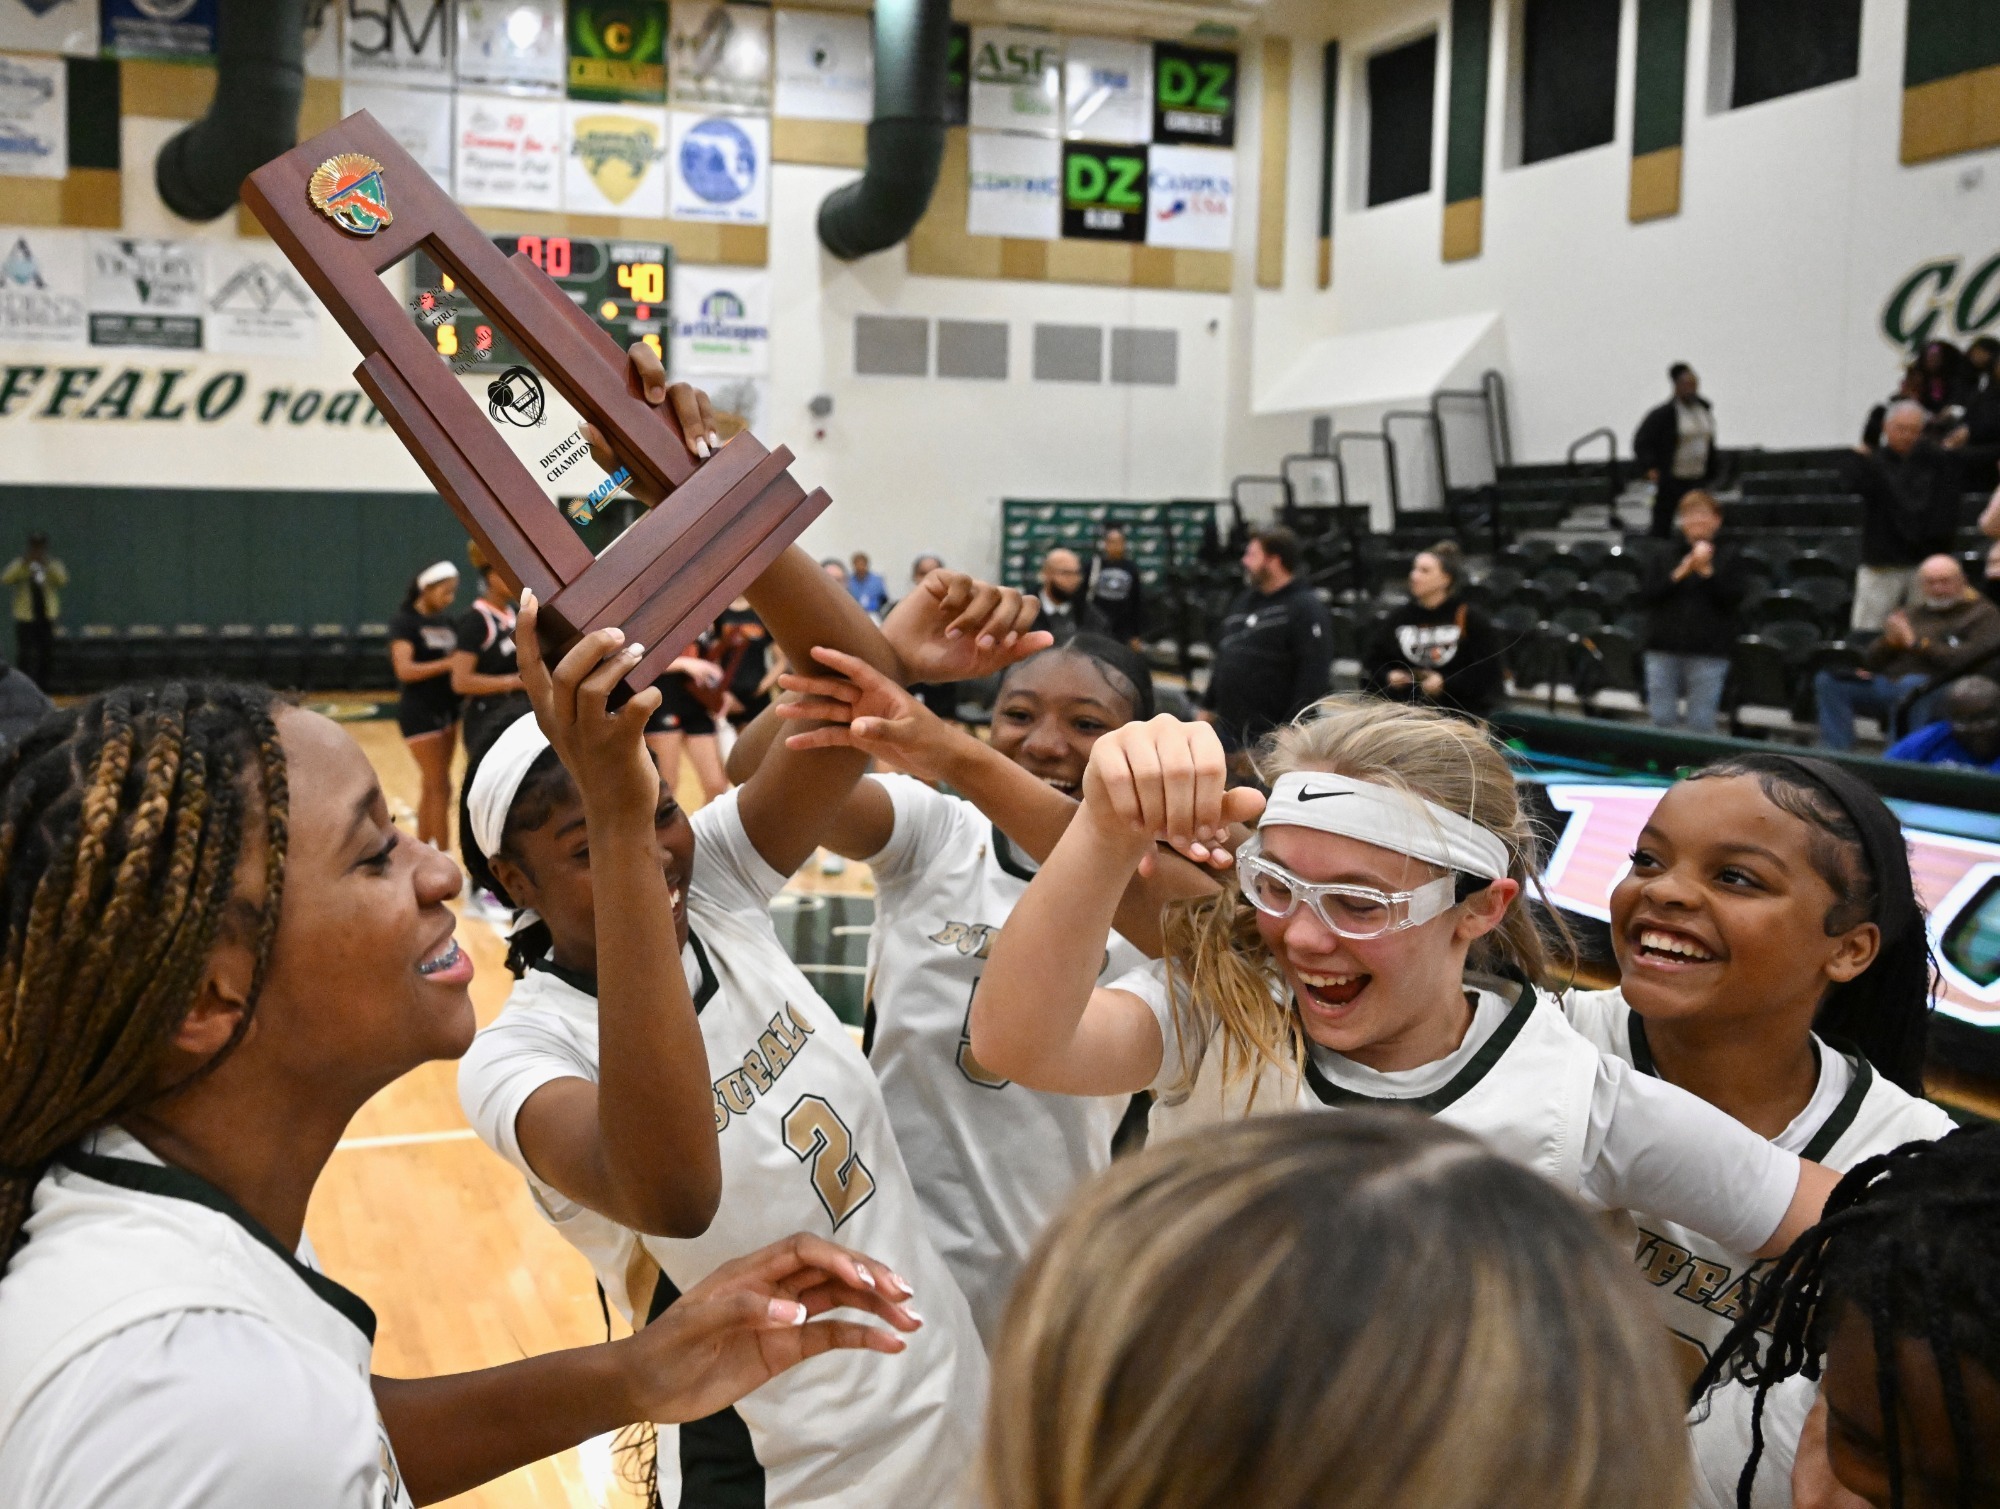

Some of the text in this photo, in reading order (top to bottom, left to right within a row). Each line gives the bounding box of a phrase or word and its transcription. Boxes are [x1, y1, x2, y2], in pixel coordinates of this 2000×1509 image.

[1157, 57, 1231, 110] DZ
[1065, 153, 1145, 206] DZ
[617, 263, 664, 304] 40
[418, 300, 444, 322] CLASS
[432, 306, 459, 328] GIRLS
[449, 329, 491, 363] BASKETBALL
[454, 336, 504, 376] CHAMPIONSHIP
[539, 430, 582, 469] DISTRICT
[546, 441, 596, 483] CHAMPION
[588, 465, 630, 507] FLORIDA
[781, 1093, 876, 1235] 2
